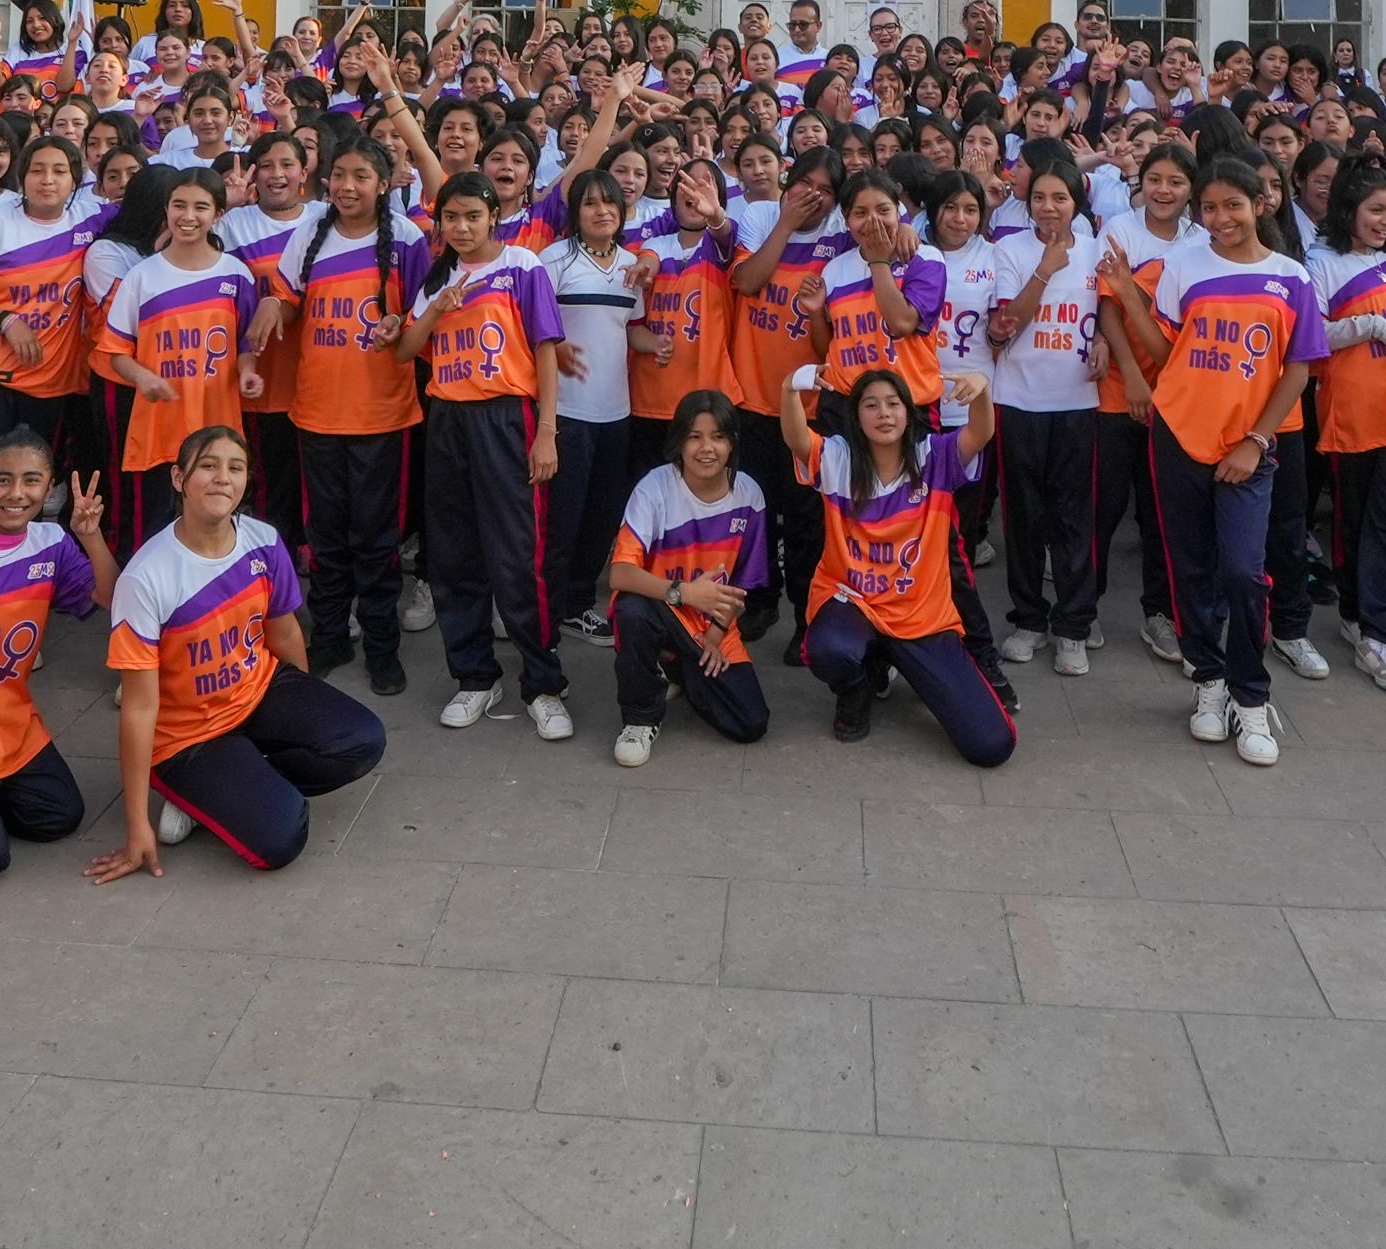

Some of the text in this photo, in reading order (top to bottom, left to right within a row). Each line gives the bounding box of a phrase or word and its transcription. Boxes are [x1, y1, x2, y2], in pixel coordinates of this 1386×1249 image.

[36, 282, 59, 302] NO
[1086, 276, 1097, 289] 25
[766, 285, 789, 306] NO
[331, 297, 353, 318] NO
[1057, 303, 1079, 324] NO
[314, 323, 347, 347] más
[856, 313, 877, 335] NO
[1216, 319, 1240, 342] NO
[155, 327, 201, 350] YA NO
[433, 326, 475, 355] YA NO
[1034, 329, 1073, 350] más
[841, 342, 879, 368] más
[1189, 346, 1231, 372] más
[160, 357, 197, 379] más
[438, 358, 473, 384] más
[869, 541, 894, 564] NO
[848, 567, 889, 593] más
[186, 641, 212, 667] YA
[195, 661, 242, 697] más
